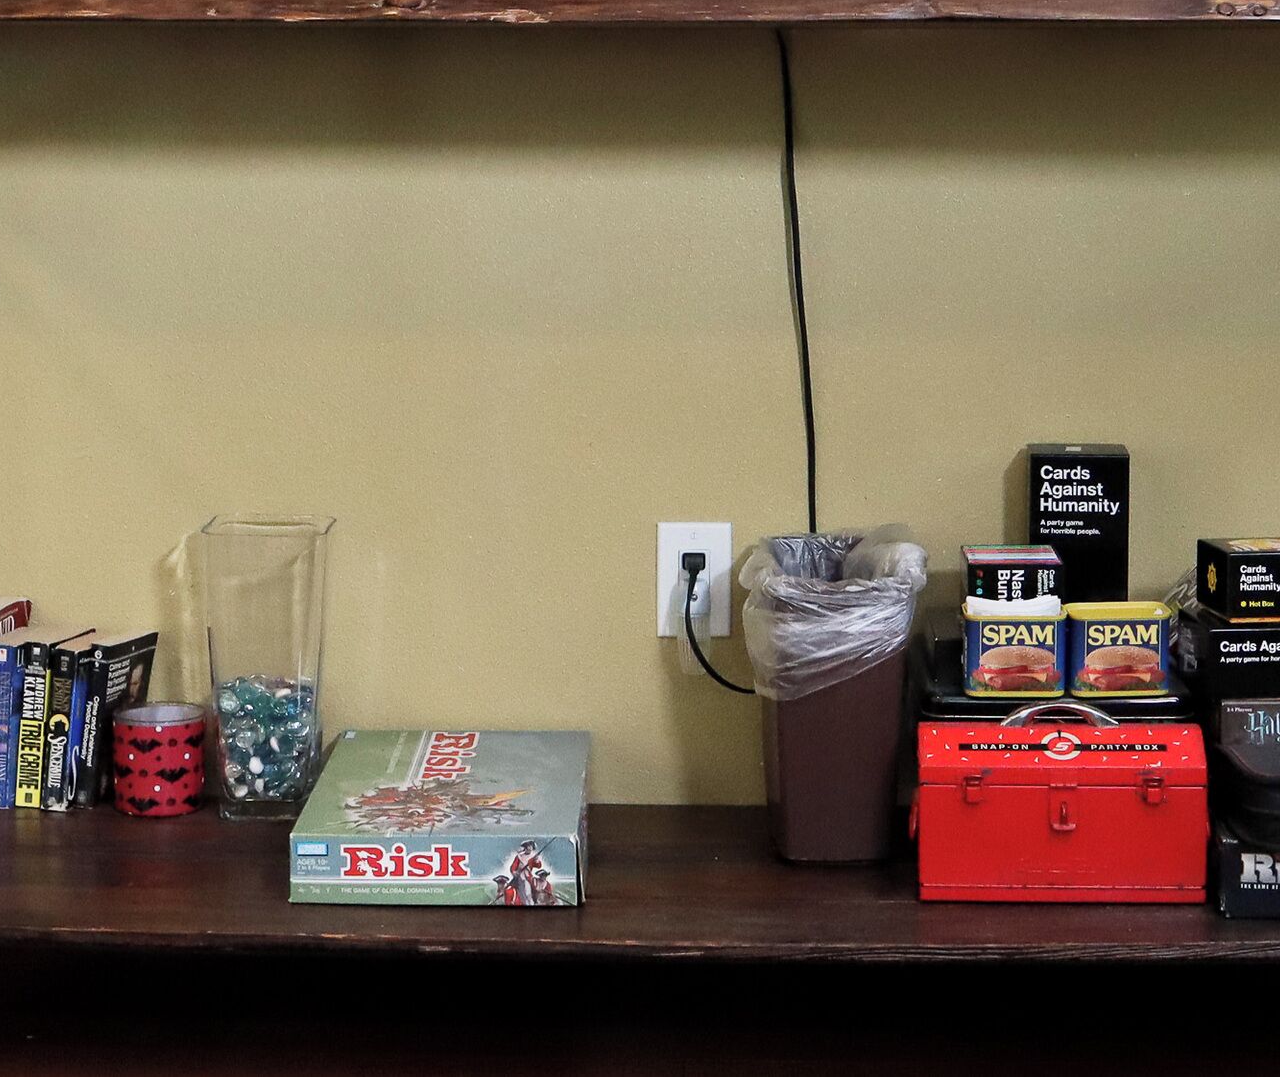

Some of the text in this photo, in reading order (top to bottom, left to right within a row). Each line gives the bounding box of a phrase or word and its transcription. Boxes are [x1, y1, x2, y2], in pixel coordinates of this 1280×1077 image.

[1040, 465, 1090, 480] Cards
[1040, 482, 1103, 500] Against
[1040, 498, 1119, 515] Humanity
[1040, 527, 1050, 535] for
[1051, 527, 1076, 535] horrible
[1047, 519, 1065, 528] party
[1066, 520, 1084, 528] game
[1240, 565, 1266, 573] Cards
[1240, 573, 1273, 584] Against
[998, 569, 1010, 601] Bun
[982, 625, 1054, 645] SPAM
[1088, 624, 1158, 645] SPAM
[1220, 640, 1257, 652] Cards
[22, 676, 35, 719] KLAVAN
[34, 677, 45, 720] ANDREW
[86, 696, 100, 766] Crime and Punishment
[19, 723, 41, 790] TRUE CRIME
[47, 733, 68, 788] SPENCERVILLE
[422, 733, 476, 779] Risk
[342, 844, 469, 878] Risk
